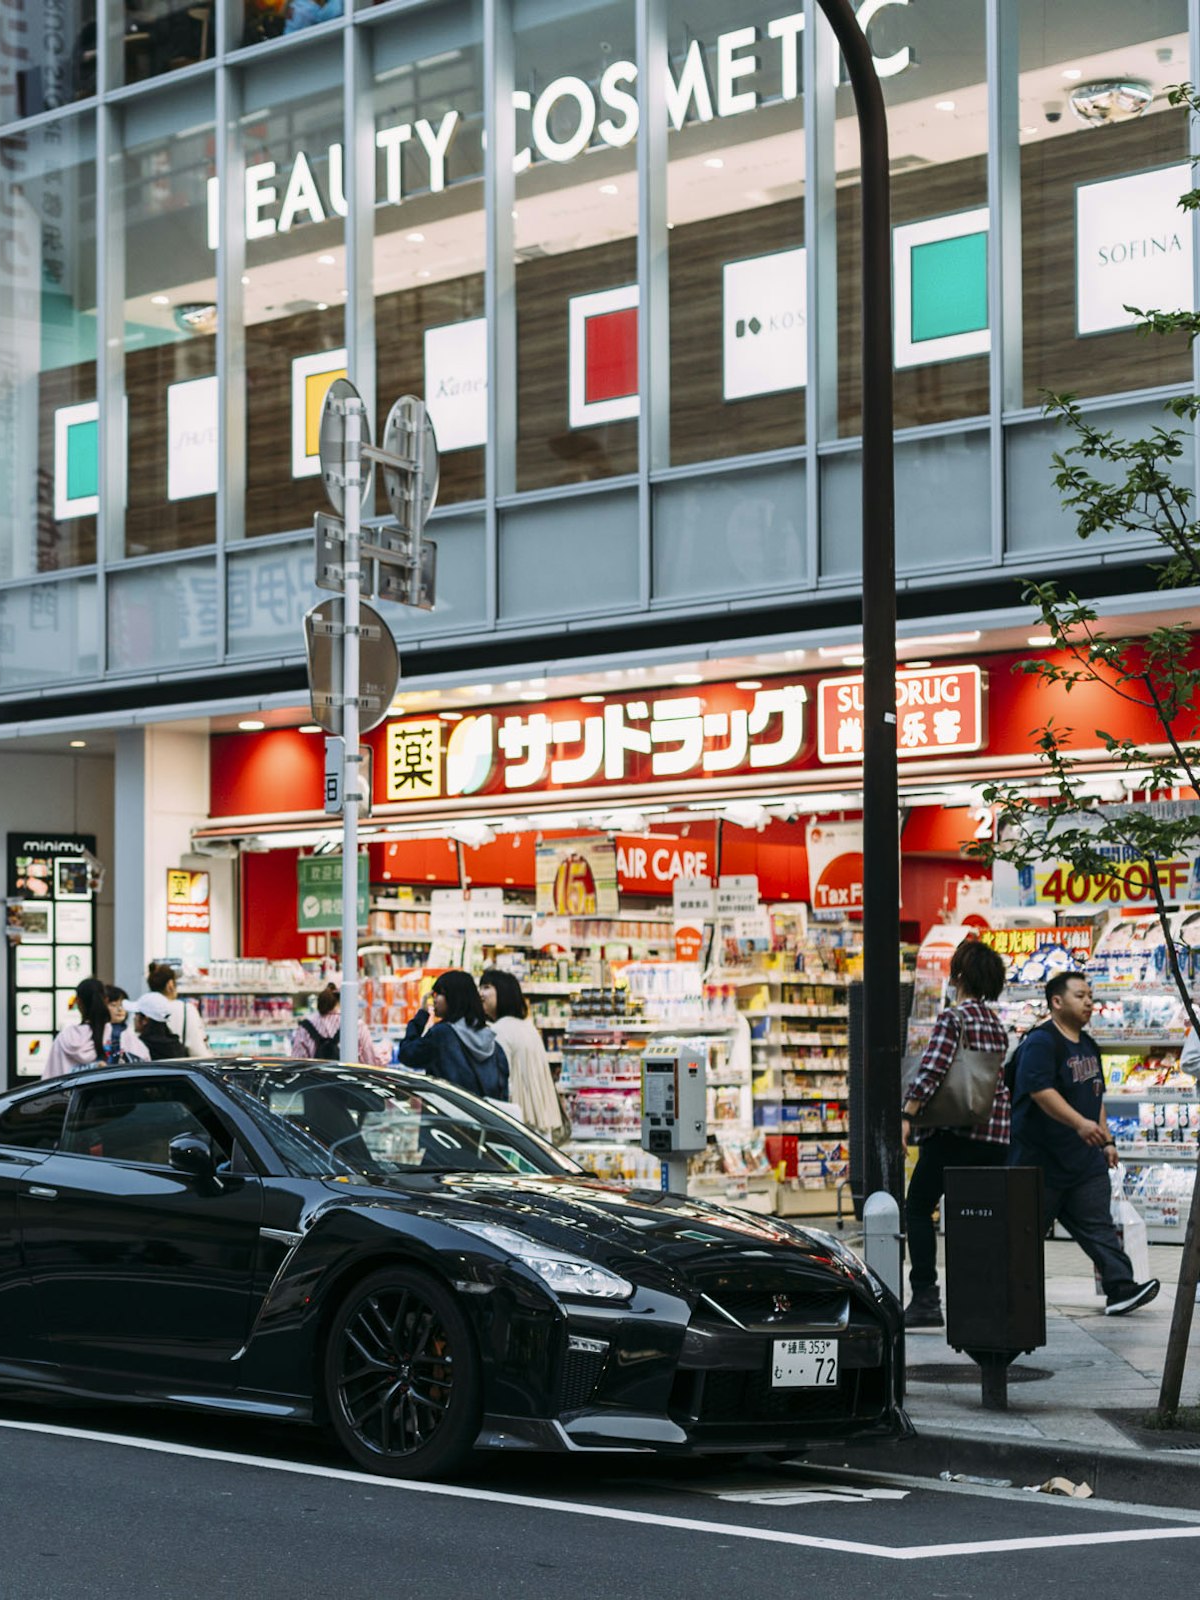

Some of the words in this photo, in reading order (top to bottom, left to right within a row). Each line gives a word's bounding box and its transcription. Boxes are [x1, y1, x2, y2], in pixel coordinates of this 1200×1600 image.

[1098, 232, 1182, 267] SOFINA
[837, 676, 961, 713] SUDRUG
[498, 684, 808, 788] サンドラッグ
[837, 708, 962, 753] 尚乐客
[394, 728, 433, 790] 薬
[23, 840, 85, 853] minimu
[652, 848, 708, 881] CARE
[817, 884, 849, 905] Tax
[808, 1340, 826, 1354] 353
[815, 1357, 837, 1384] 72
